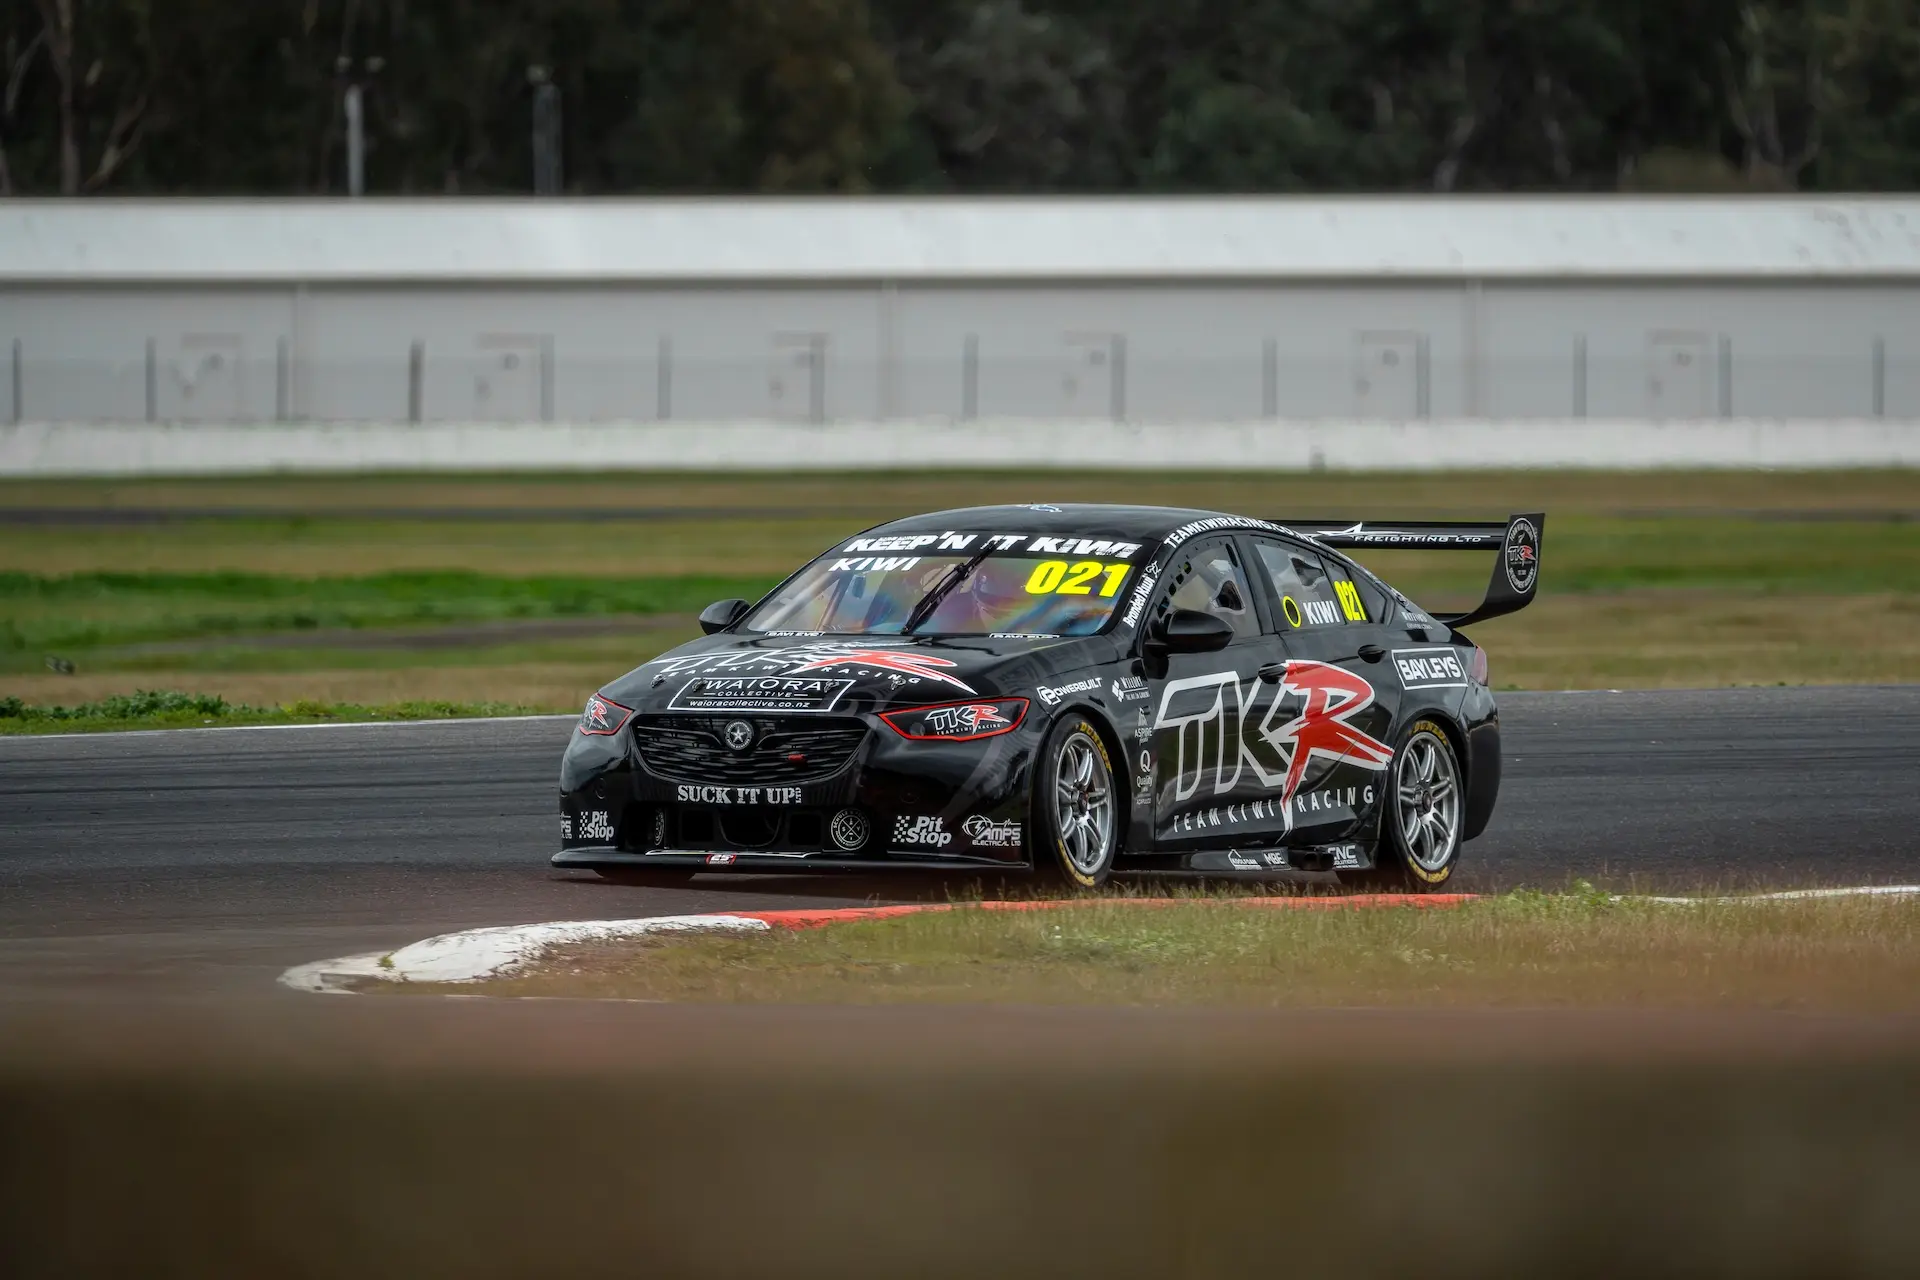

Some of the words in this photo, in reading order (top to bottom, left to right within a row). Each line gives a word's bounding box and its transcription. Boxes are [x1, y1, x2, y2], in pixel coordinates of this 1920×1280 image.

[843, 531, 977, 553] KEEP'N
[1026, 537, 1142, 558] KIWI
[1354, 535, 1449, 543] FREIGHTING
[828, 557, 921, 572] KIWI
[1025, 561, 1132, 597] 021
[1334, 581, 1367, 621] 021
[1303, 600, 1340, 624] KIWI
[823, 666, 921, 684] RACING
[1397, 656, 1461, 680] BAYLEYS
[704, 679, 822, 691] WAIORA
[689, 700, 811, 708] waioracollective.co.nz
[925, 704, 1011, 734] TKR
[1153, 659, 1396, 838] TKR
[1136, 775, 1153, 788] Quality
[677, 785, 732, 803] SUCK
[737, 787, 760, 804] IT
[766, 787, 796, 804] UP
[592, 811, 608, 826] Pit
[1173, 807, 1221, 833] TEAM
[1227, 800, 1275, 823] KIWI
[1297, 785, 1374, 813] RACING
[587, 822, 614, 841] Stop
[915, 816, 944, 832] Pit
[976, 827, 1021, 840] AMPS
[906, 828, 952, 847] Stop
[1263, 852, 1286, 865] MBE
